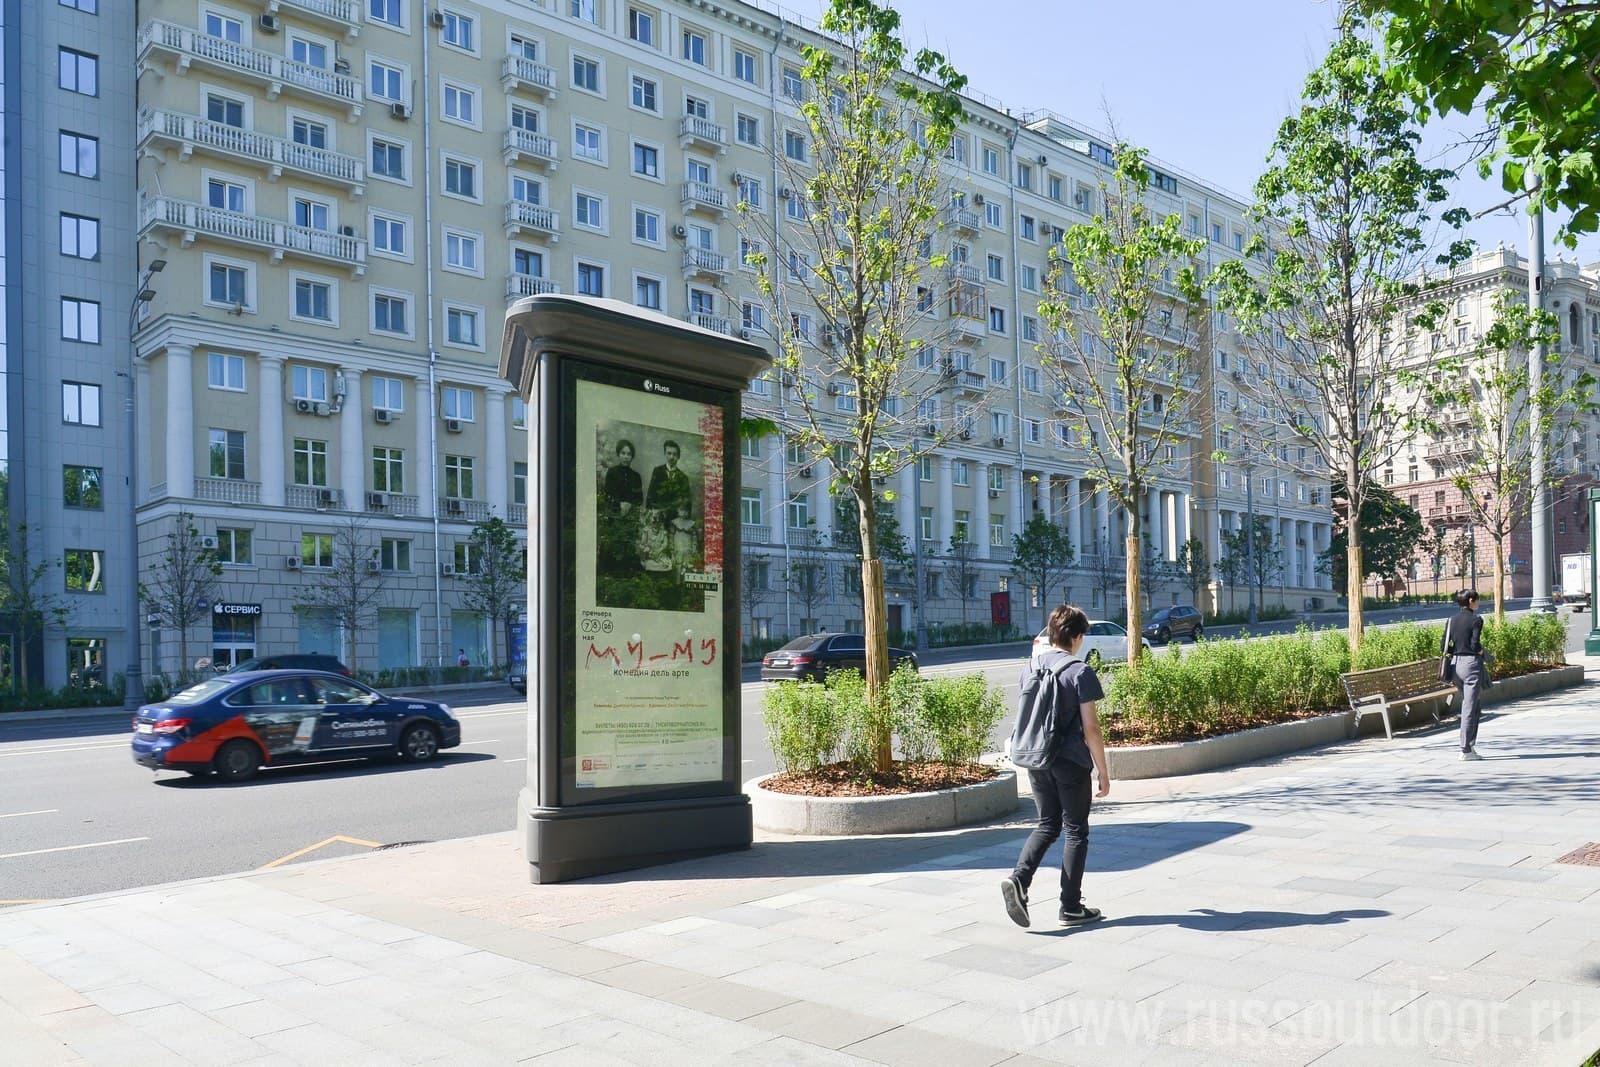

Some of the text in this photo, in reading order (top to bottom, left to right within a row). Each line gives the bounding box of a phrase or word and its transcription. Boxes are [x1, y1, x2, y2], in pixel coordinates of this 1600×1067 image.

[654, 383, 670, 393] Russ
[224, 605, 260, 614] СЕРВИС
[613, 669, 649, 677] комедия
[650, 669, 670, 677] дель
